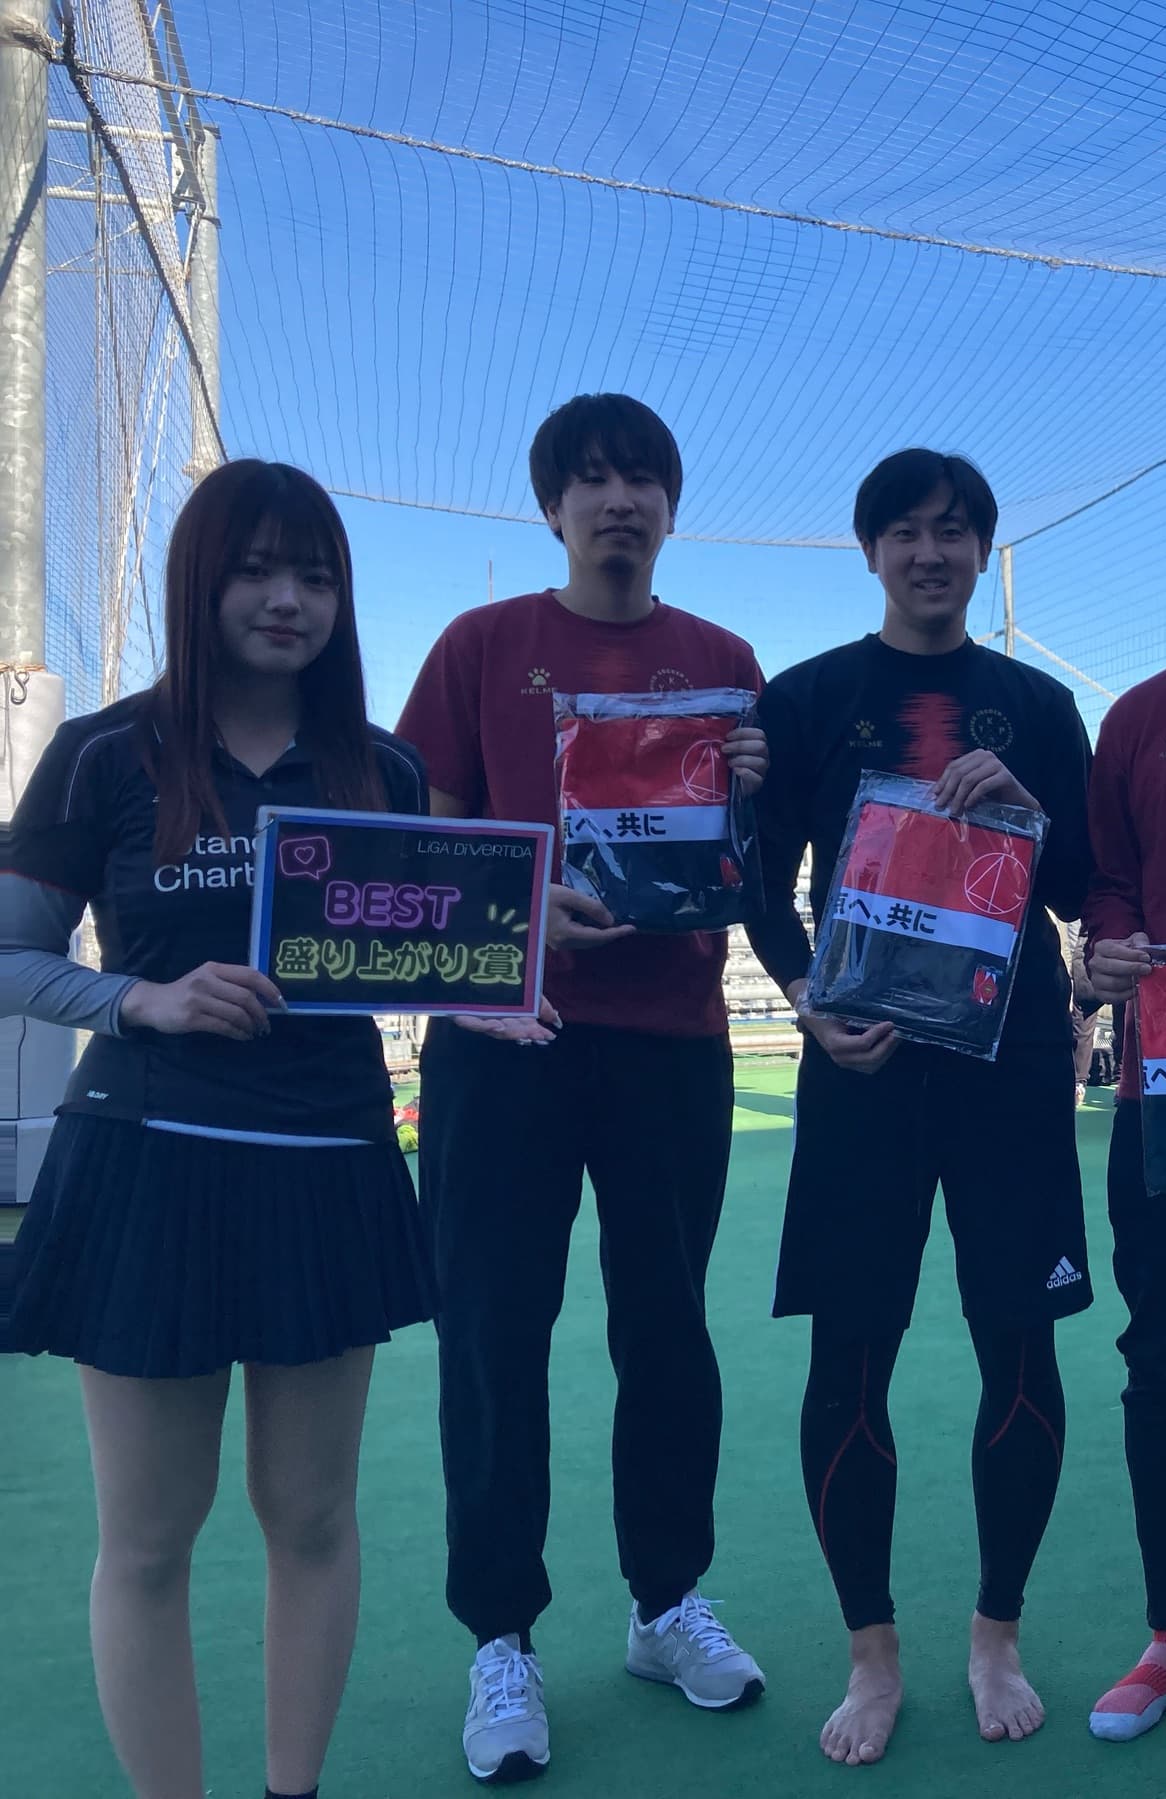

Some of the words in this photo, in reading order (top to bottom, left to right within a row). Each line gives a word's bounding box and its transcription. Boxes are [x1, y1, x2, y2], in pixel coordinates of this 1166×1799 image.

[183, 832, 256, 855] tan
[324, 880, 462, 930] BEST
[275, 936, 524, 985] 盛り上がり賞
[1046, 1270, 1082, 1289] adidas
